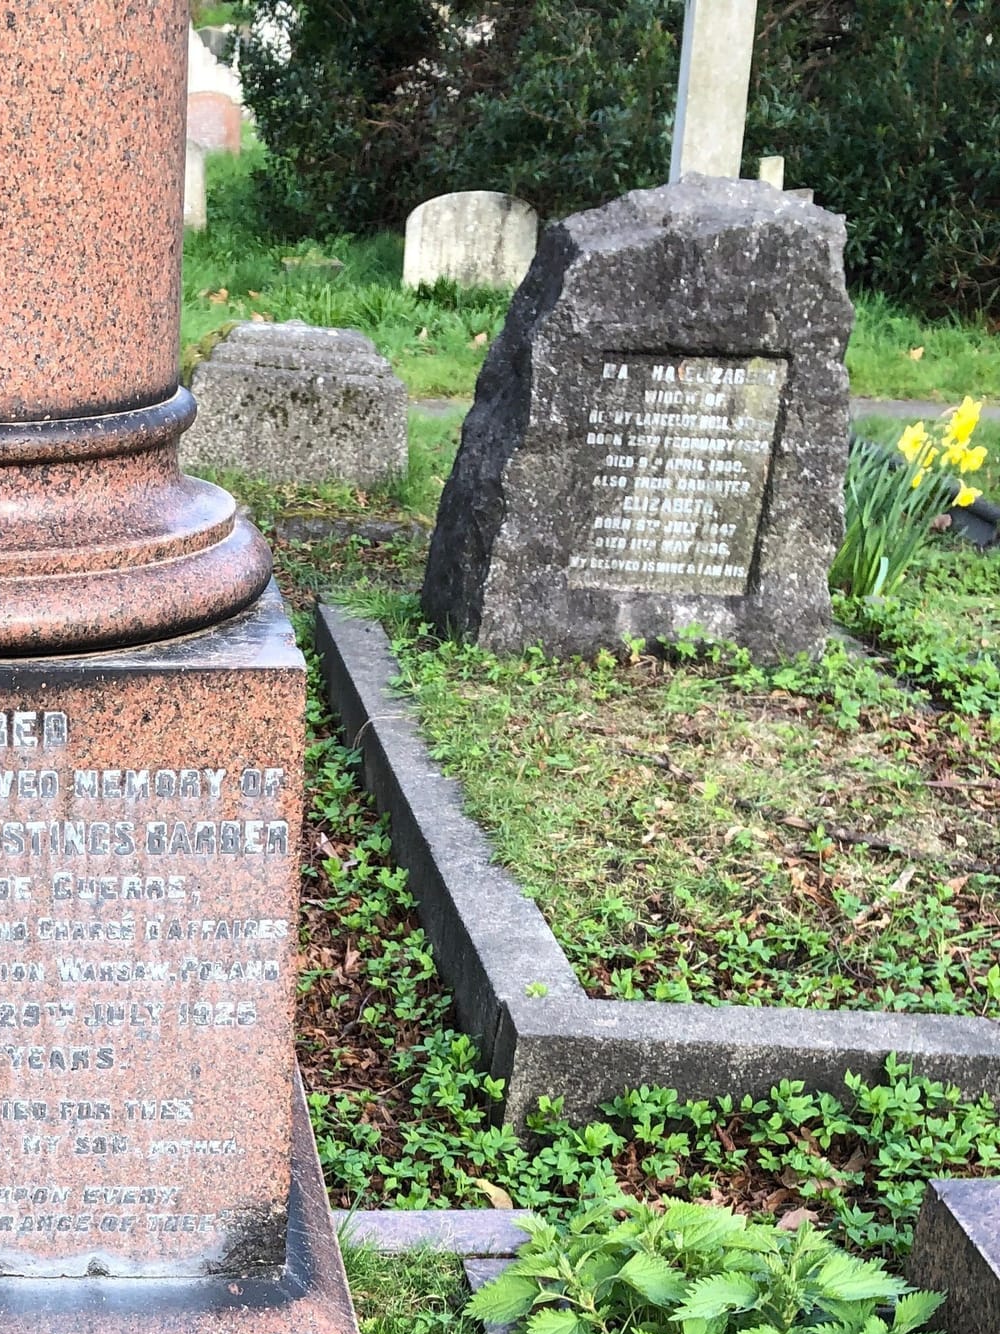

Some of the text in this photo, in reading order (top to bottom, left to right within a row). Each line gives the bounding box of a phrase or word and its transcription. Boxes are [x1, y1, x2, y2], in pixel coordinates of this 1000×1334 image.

[705, 393, 726, 406] OF
[589, 410, 631, 424] HERY
[587, 433, 622, 445] BORN
[664, 437, 735, 451] FEBRUARY
[606, 455, 634, 468] DIED
[665, 458, 705, 471] APRIL
[593, 476, 750, 496] ALSO THEIR DAUGHTER
[594, 517, 631, 530] BORN
[664, 521, 698, 534] JULY
[596, 537, 626, 549] DIED
[661, 540, 693, 553] MAY
[590, 558, 639, 571] BELOVED
[657, 562, 684, 574] MINE
[73, 769, 227, 798] MEMORY
[241, 768, 284, 798] OF
[146, 820, 289, 855] BARBER
[181, 958, 280, 982] POLAND
[84, 1002, 164, 1027] JULY
[179, 1001, 257, 1026] 1925
[60, 1099, 111, 1121] FOR
[124, 1098, 194, 1121] THEE
[22, 1136, 61, 1155] MY
[83, 1186, 180, 1205] EVERY
[100, 1215, 137, 1233] OF
